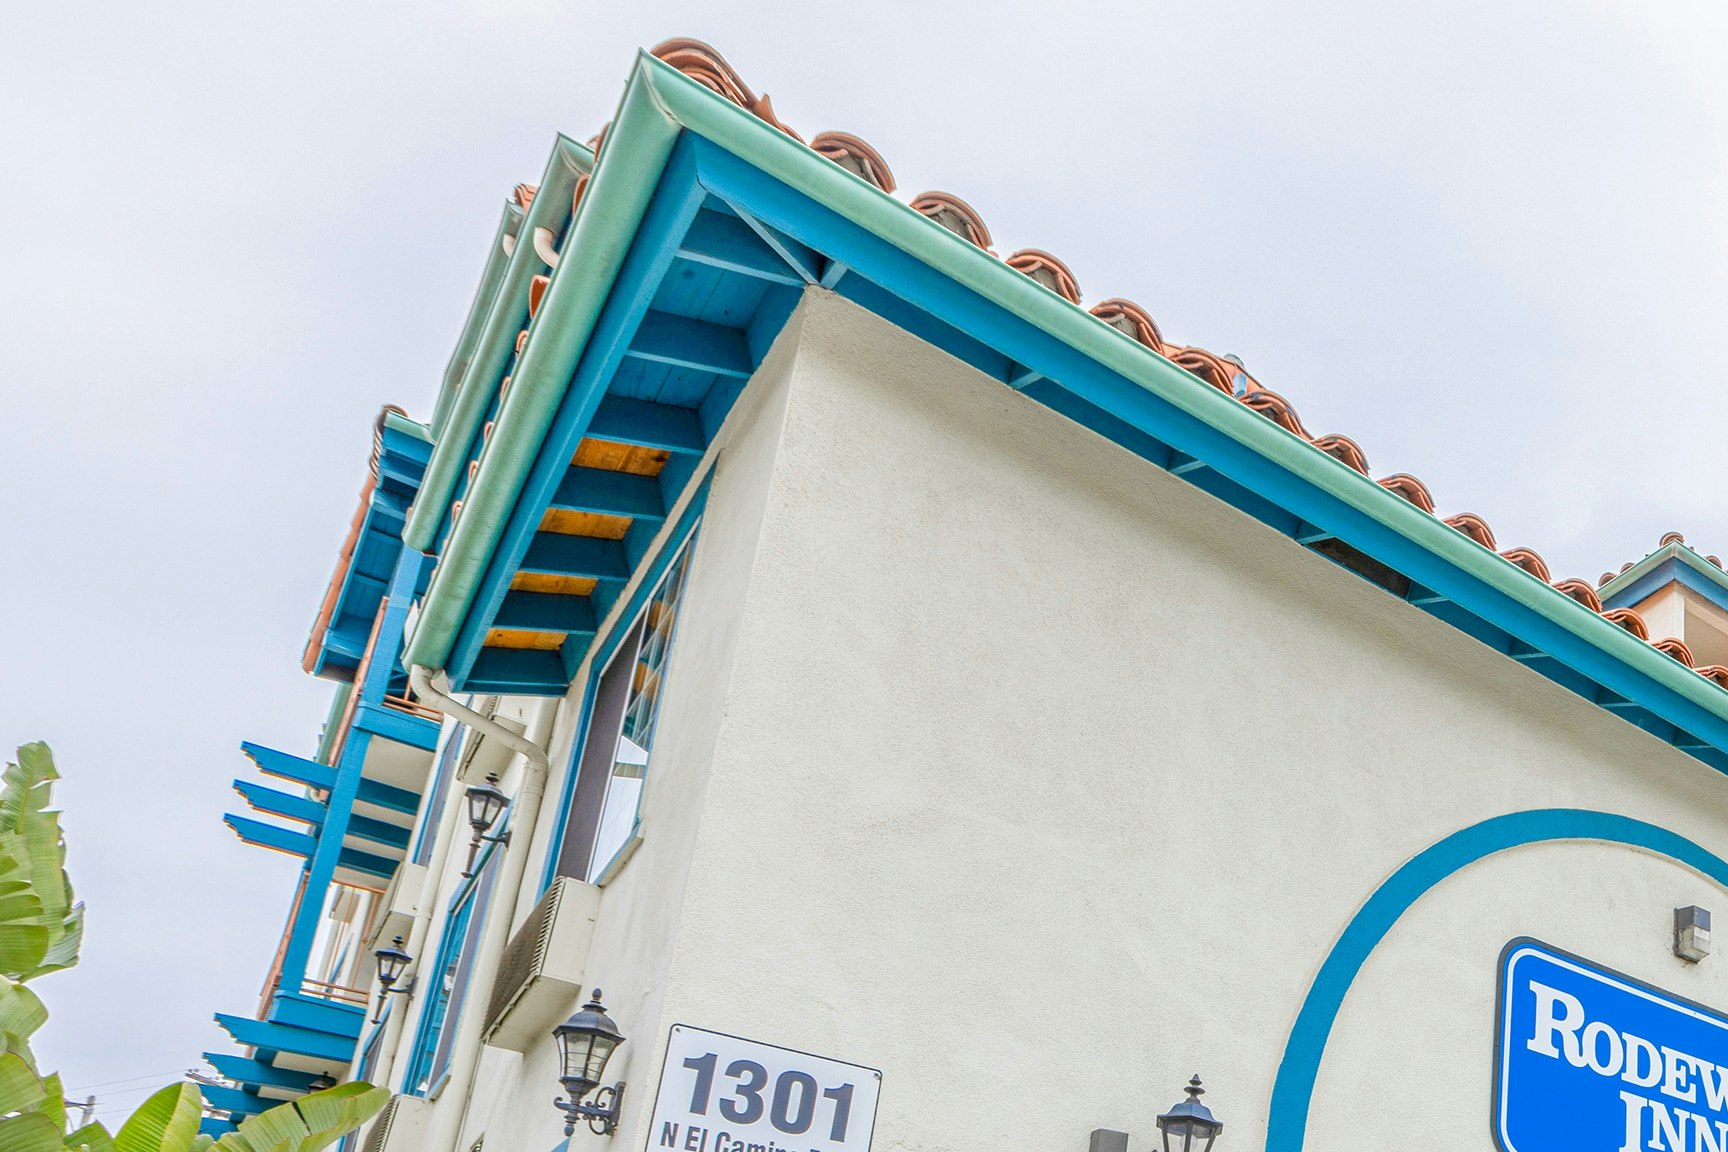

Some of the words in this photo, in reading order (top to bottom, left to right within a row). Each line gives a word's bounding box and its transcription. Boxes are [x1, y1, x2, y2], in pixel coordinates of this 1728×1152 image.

[683, 1053, 854, 1143] 1301
[660, 1122, 679, 1148] N
[685, 1127, 708, 1152] El
